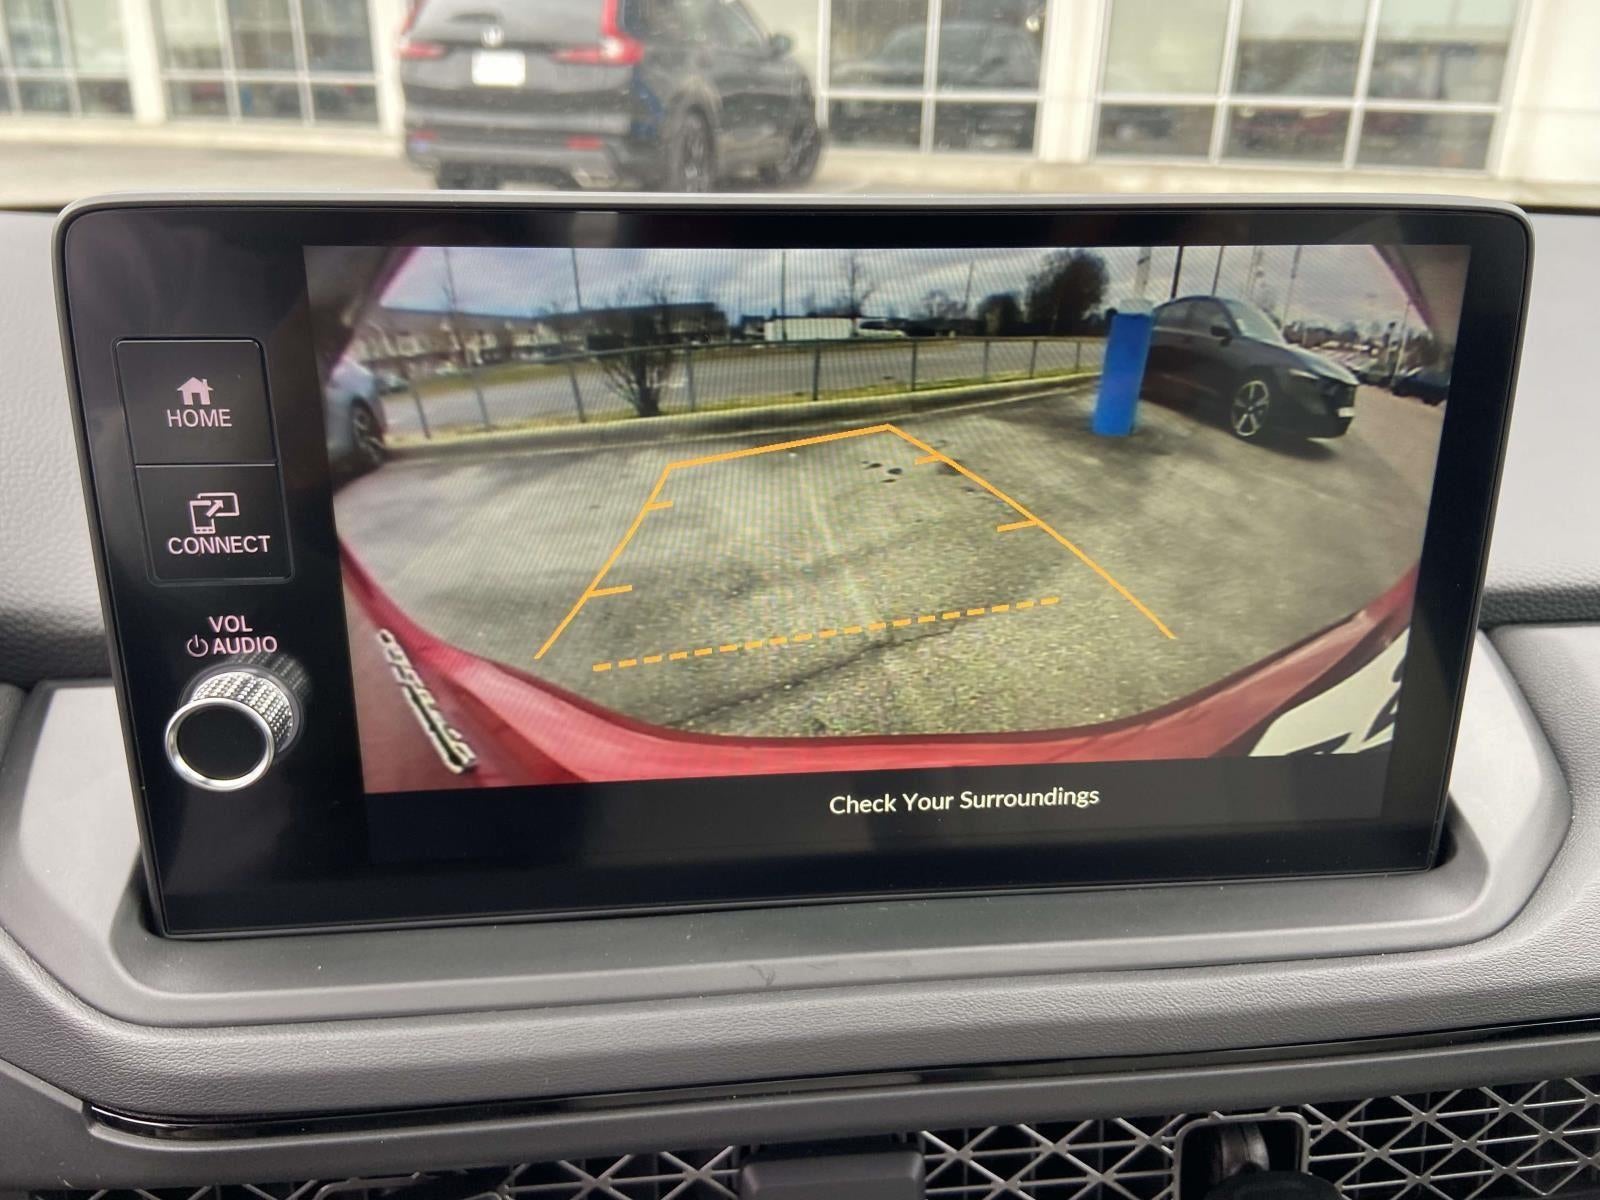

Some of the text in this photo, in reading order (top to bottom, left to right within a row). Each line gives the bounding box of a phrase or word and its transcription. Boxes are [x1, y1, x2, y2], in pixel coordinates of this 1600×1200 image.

[166, 408, 232, 428] HOME
[168, 535, 270, 555] CONNECT
[208, 615, 253, 633] VOL
[212, 635, 278, 655] AUDIO
[829, 786, 1100, 815] Check Your Surroundings
